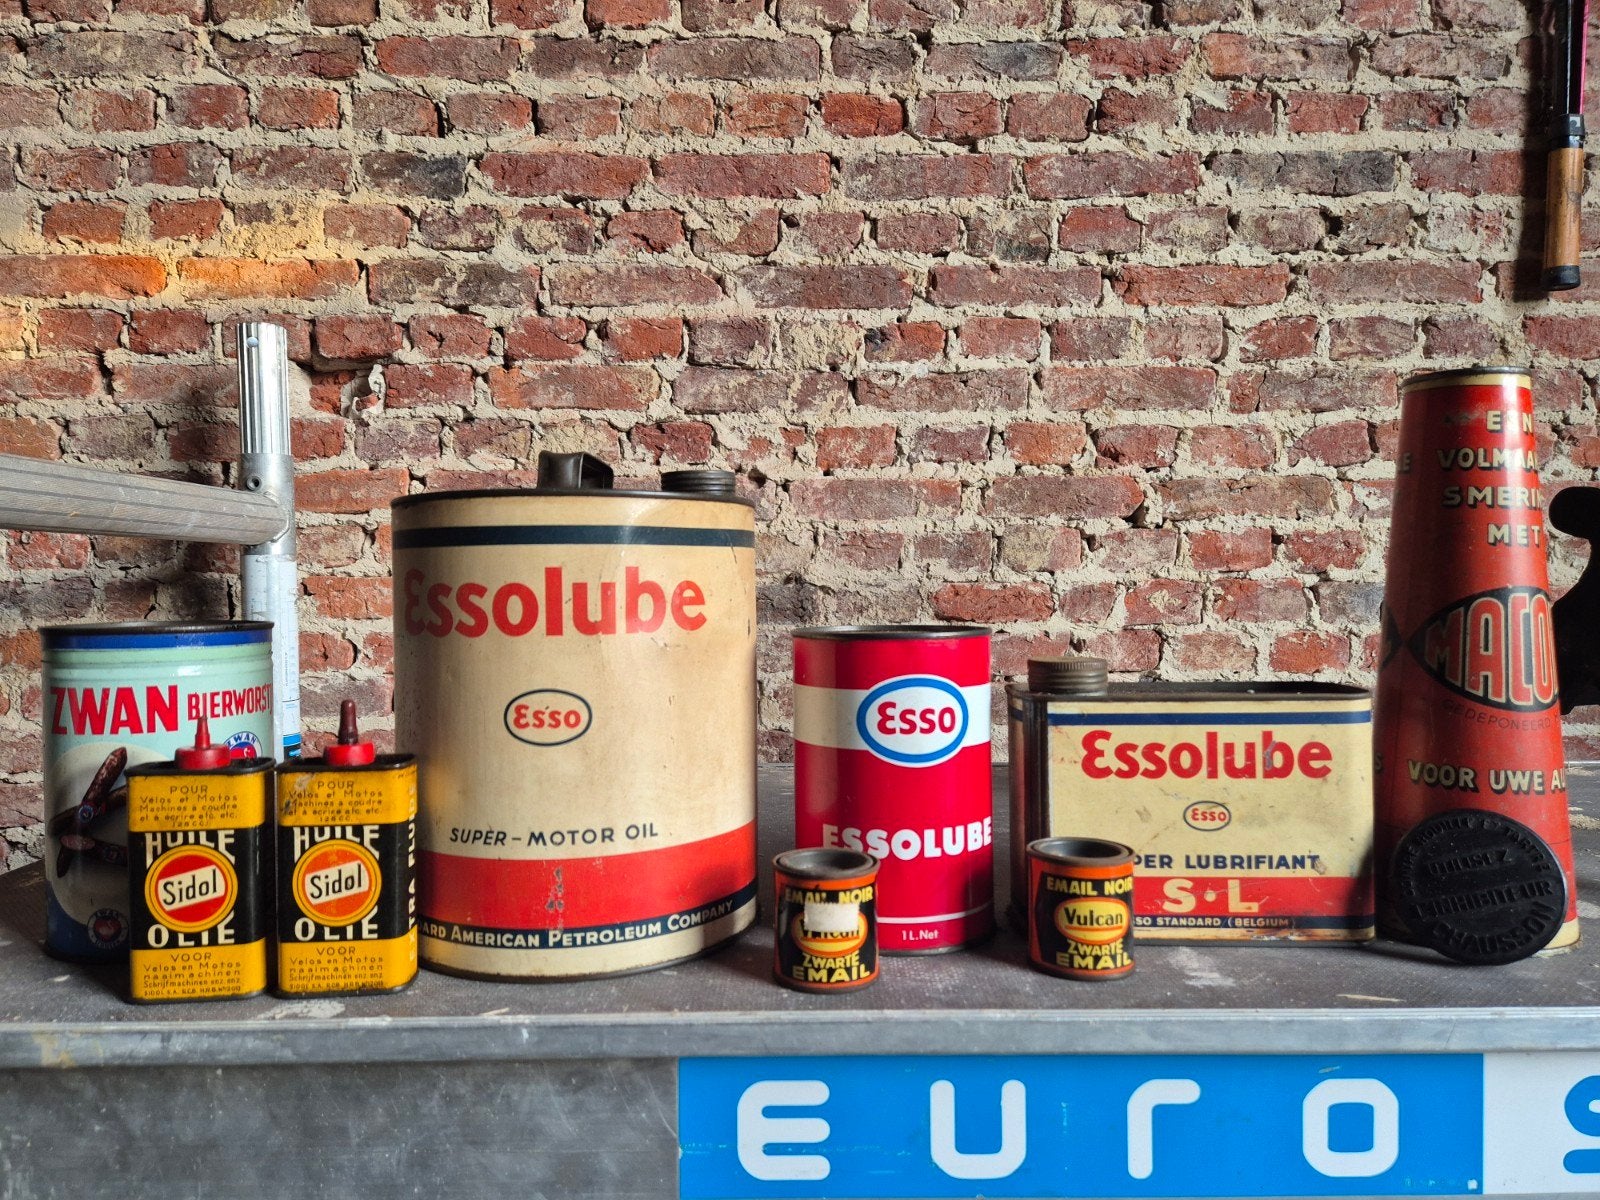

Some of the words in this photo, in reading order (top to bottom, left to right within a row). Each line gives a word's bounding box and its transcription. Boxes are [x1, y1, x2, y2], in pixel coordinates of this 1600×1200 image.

[1488, 523, 1541, 546] MET
[404, 566, 707, 638] Essolube
[51, 685, 178, 735] ZWAN
[513, 703, 581, 730] Esso
[877, 701, 956, 735] Esso
[1081, 730, 1333, 780] Essolube
[317, 781, 354, 789] POUR
[1408, 760, 1476, 790] VOOR
[1489, 769, 1544, 792] UWE
[170, 785, 208, 794] POUR
[1191, 808, 1227, 822] Esso
[293, 825, 380, 864] HUILE
[450, 827, 507, 846] SUPER
[527, 828, 615, 847] MOTOR
[626, 823, 658, 840] OIL
[823, 816, 991, 860] ESSOLUBE
[145, 829, 236, 870] HUILE
[1185, 855, 1320, 870] LUBRIFIANT
[163, 868, 217, 906] Sidol
[310, 862, 362, 900] Sidol
[1047, 876, 1097, 896] EMAIL
[839, 886, 873, 904] NOIR
[294, 905, 379, 942] OLIE
[451, 926, 540, 947] AMERICAN
[548, 922, 661, 947] PETROLEUM
[667, 899, 734, 931] COMPANY
[1064, 907, 1123, 926] Vulcan
[1156, 917, 1222, 927] STANDARD
[147, 910, 235, 948] OLIE
[170, 952, 212, 962] VOOR
[316, 946, 356, 956] VOOR
[1067, 938, 1123, 956] ZWARTE
[802, 950, 859, 969] ZWARTE
[1056, 951, 1132, 970] EMAIL
[793, 964, 870, 983] EMAIL
